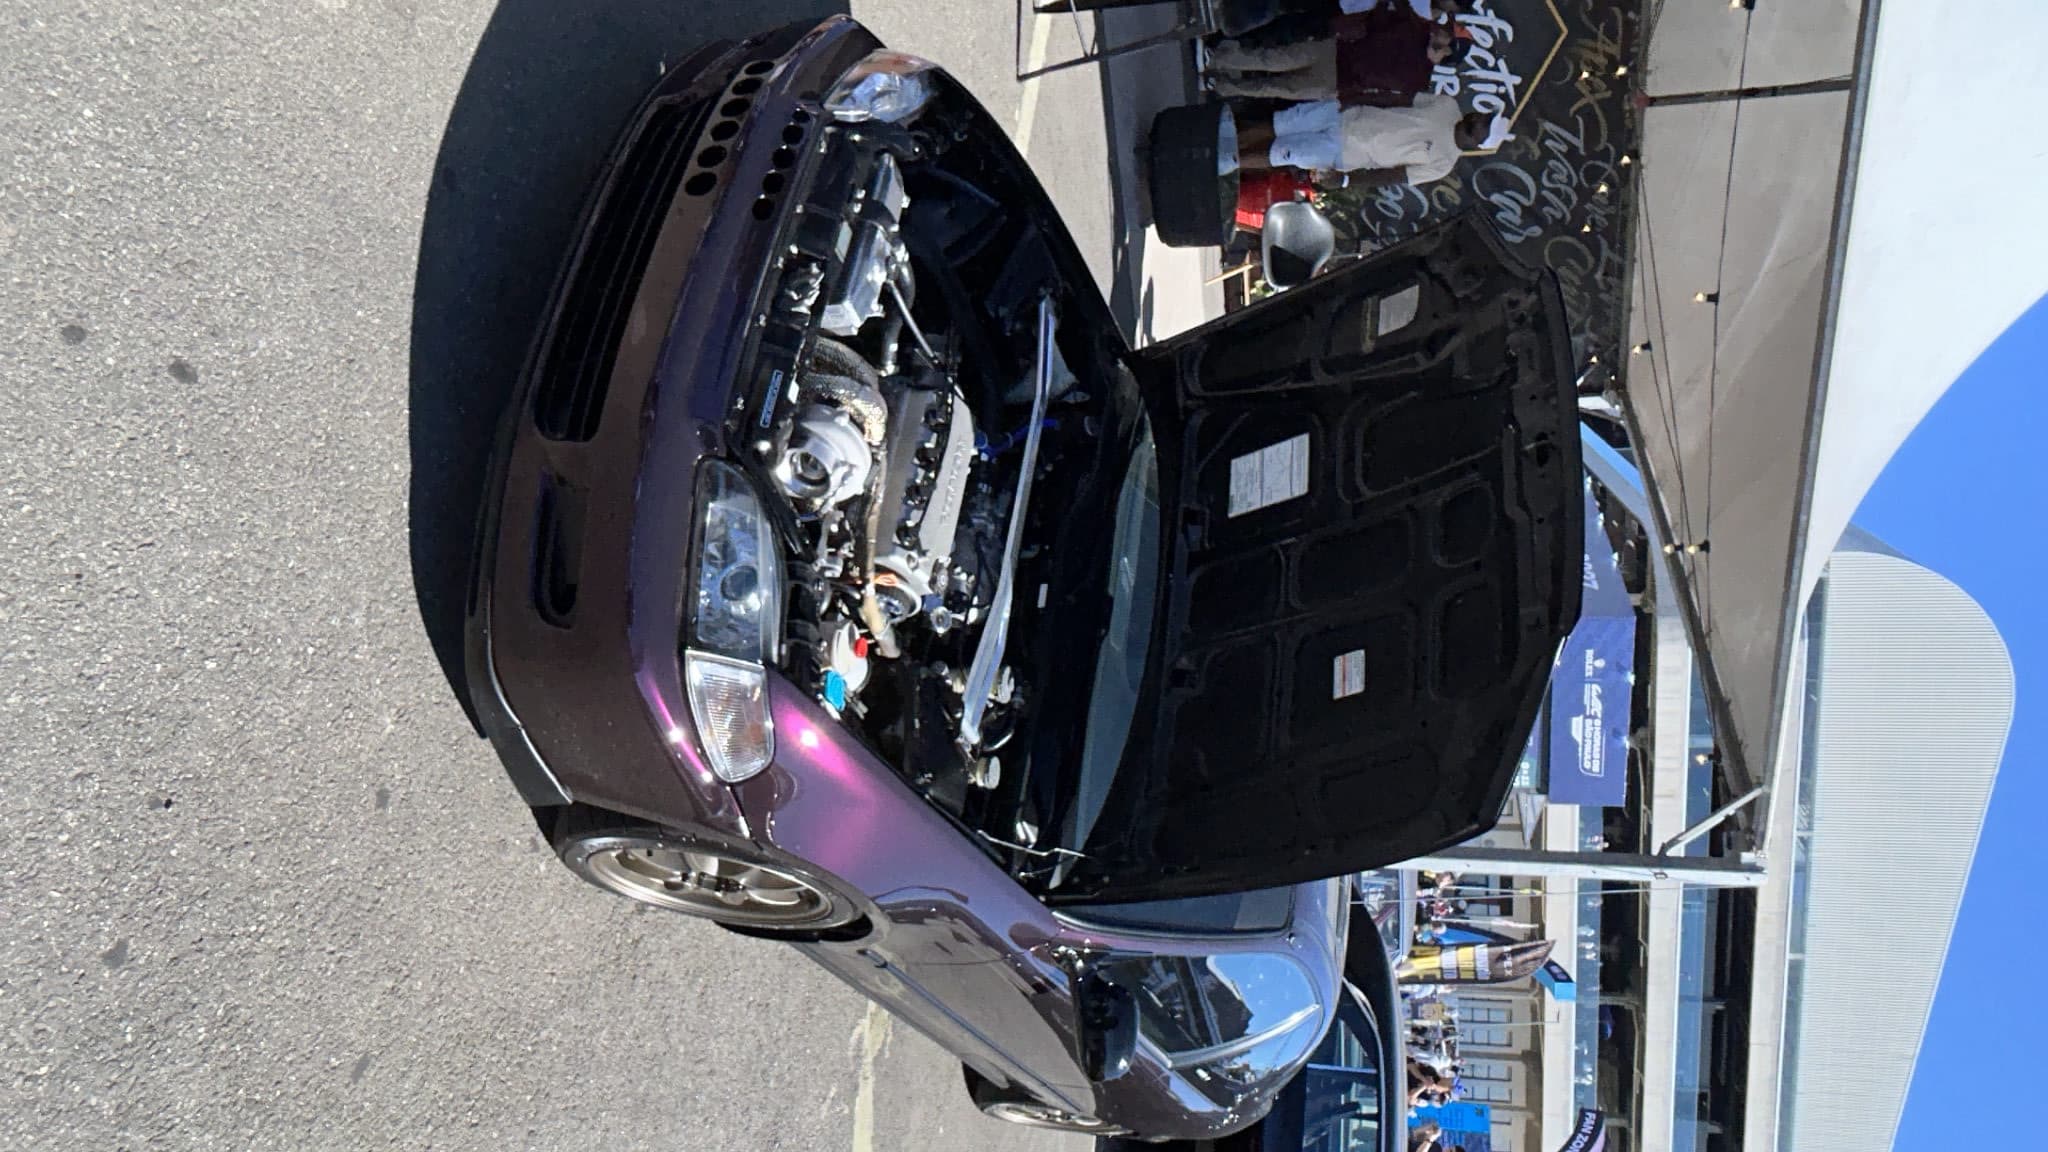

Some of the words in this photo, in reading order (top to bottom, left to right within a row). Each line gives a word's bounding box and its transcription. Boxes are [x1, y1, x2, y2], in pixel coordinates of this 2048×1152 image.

[1455, 0, 1522, 114] fectio
[1472, 162, 1543, 244] Car
[1540, 115, 1586, 225] Wash
[1565, 1133, 1589, 1152] ZON
[1581, 1112, 1596, 1134] FAN
